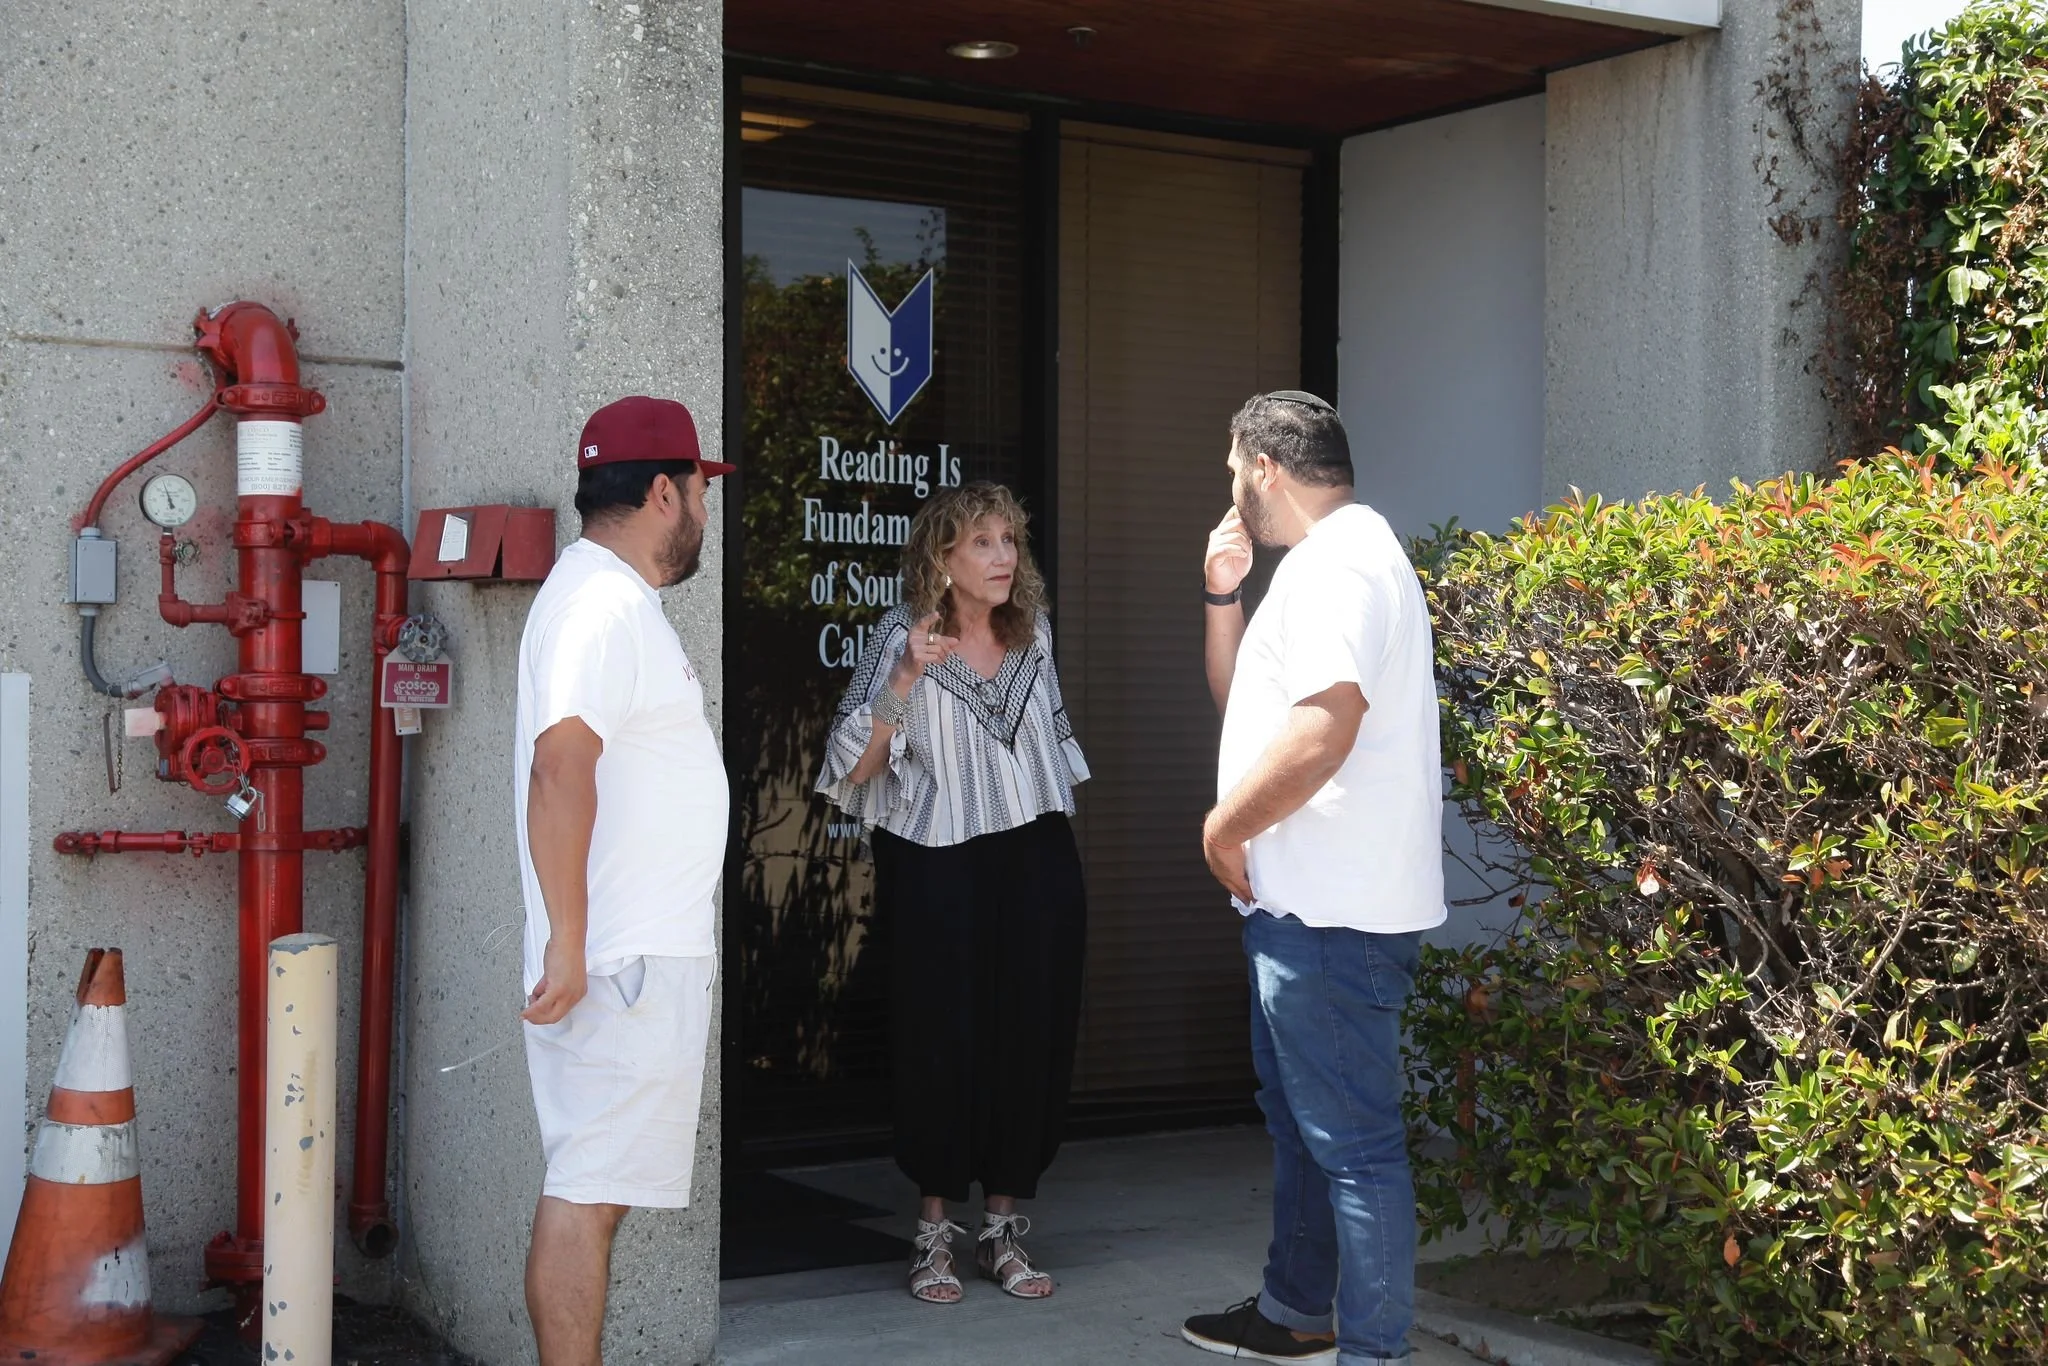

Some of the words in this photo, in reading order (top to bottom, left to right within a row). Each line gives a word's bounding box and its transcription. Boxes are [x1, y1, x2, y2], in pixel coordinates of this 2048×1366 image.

[819, 436, 930, 498] Reading
[938, 444, 961, 487] Is
[802, 498, 911, 546] Fundam
[811, 561, 838, 605] of
[847, 562, 905, 607] Sout
[398, 664, 415, 672] MAIN
[417, 664, 437, 673] DRAIN
[399, 681, 435, 691] COSCO
[827, 823, 860, 839] www
